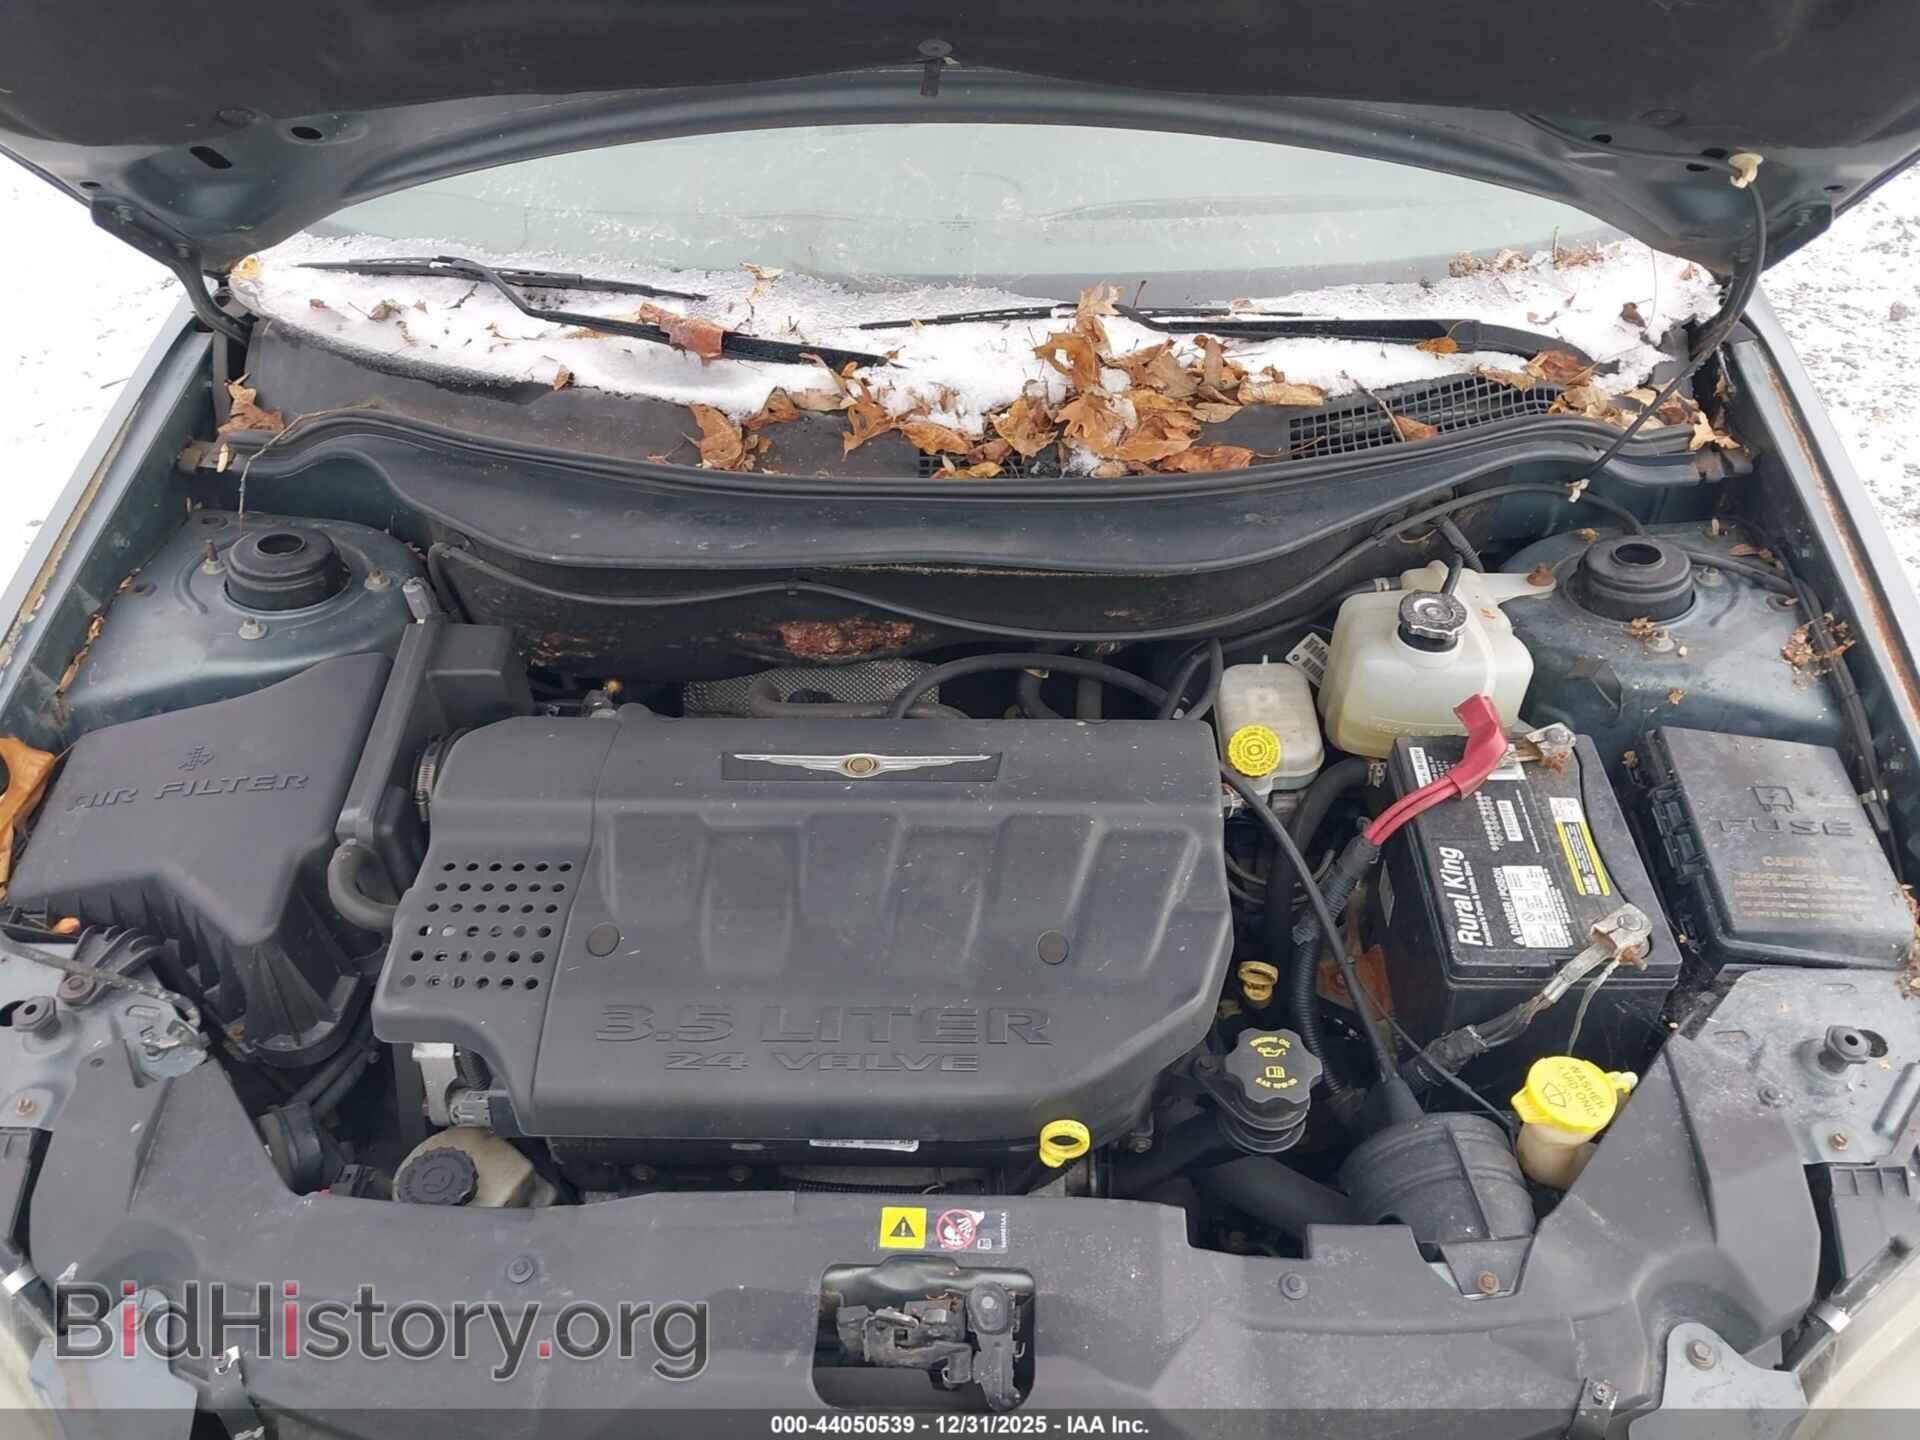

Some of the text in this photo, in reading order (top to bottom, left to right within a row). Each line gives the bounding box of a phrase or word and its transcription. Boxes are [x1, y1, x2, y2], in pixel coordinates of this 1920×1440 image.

[66, 773, 309, 812] AIR FILTER
[1713, 819, 1857, 837] FUSE
[1438, 846, 1483, 946] Rural King
[1492, 866, 1508, 896] POISON
[1501, 901, 1520, 935] DANGER
[595, 1003, 1056, 1046] 3.5 LITER
[1279, 1038, 1291, 1049] OIL
[664, 1050, 980, 1073] 24 VALVE
[1575, 1091, 1601, 1119] ONLY
